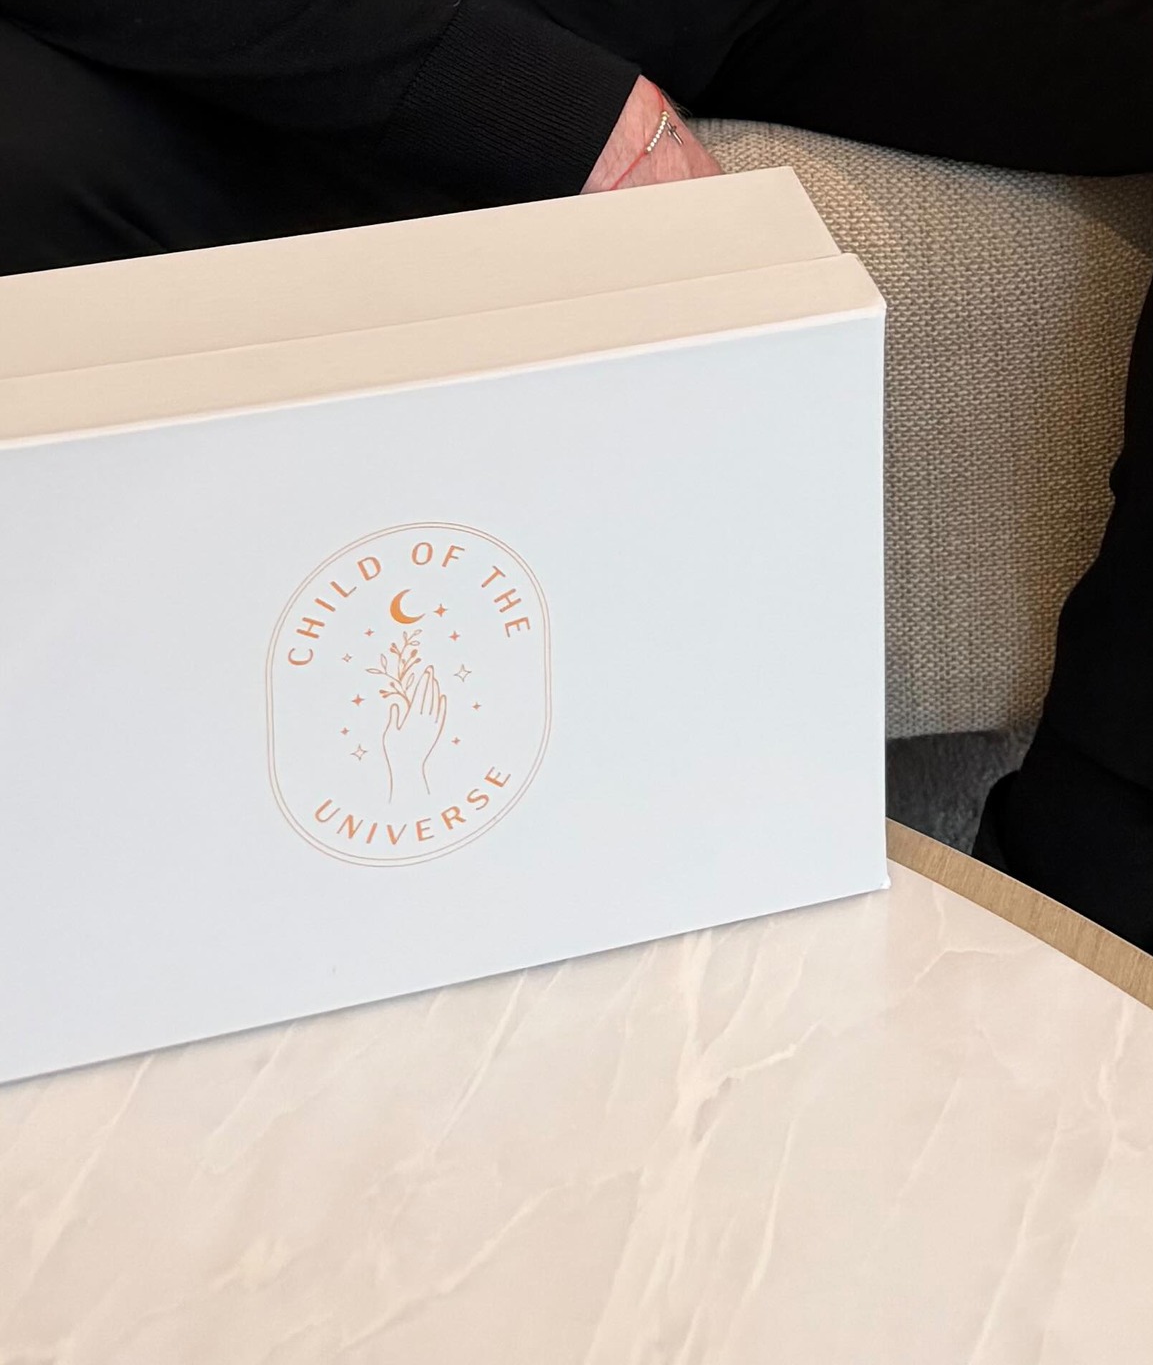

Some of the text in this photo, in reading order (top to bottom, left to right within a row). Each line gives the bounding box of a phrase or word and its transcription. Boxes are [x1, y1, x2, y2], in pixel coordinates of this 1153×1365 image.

[288, 541, 531, 666] CHILD OF THE
[314, 766, 511, 846] UNIVERSE
